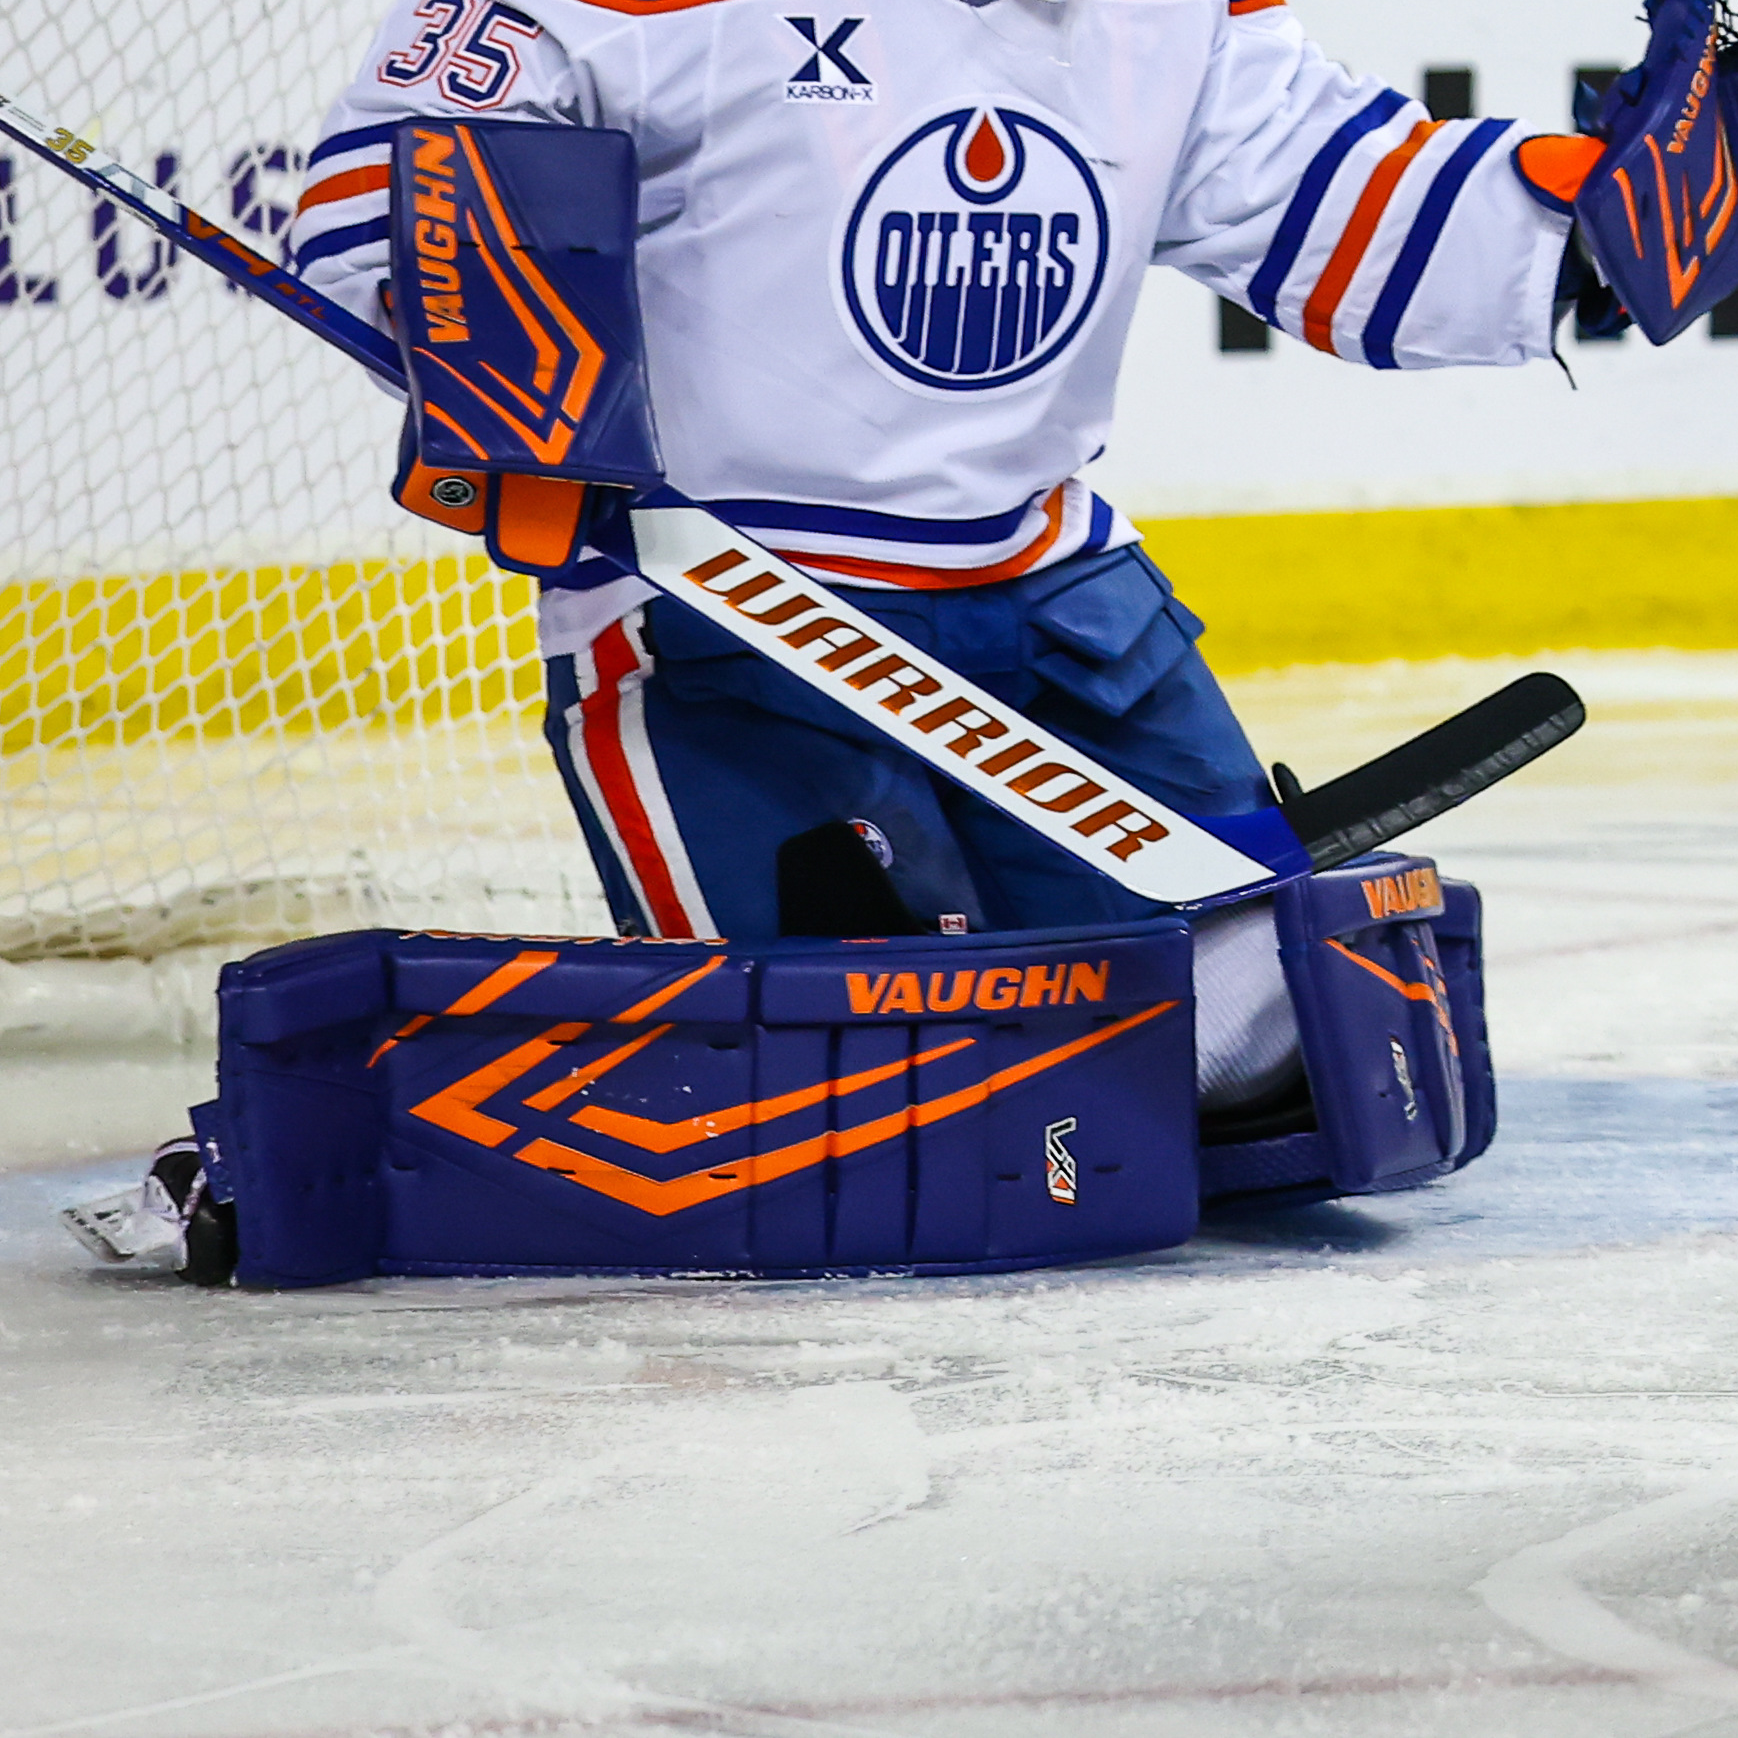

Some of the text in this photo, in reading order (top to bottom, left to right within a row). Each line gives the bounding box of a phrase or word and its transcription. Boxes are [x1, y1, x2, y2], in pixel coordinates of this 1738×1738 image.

[45, 127, 97, 164] 35
[785, 85, 875, 103] KARBON-X
[410, 128, 471, 344] VAUGHN
[875, 211, 1079, 362] OILERS
[682, 547, 1171, 863] WARRIOR
[846, 959, 1111, 1016] VAUGHN
